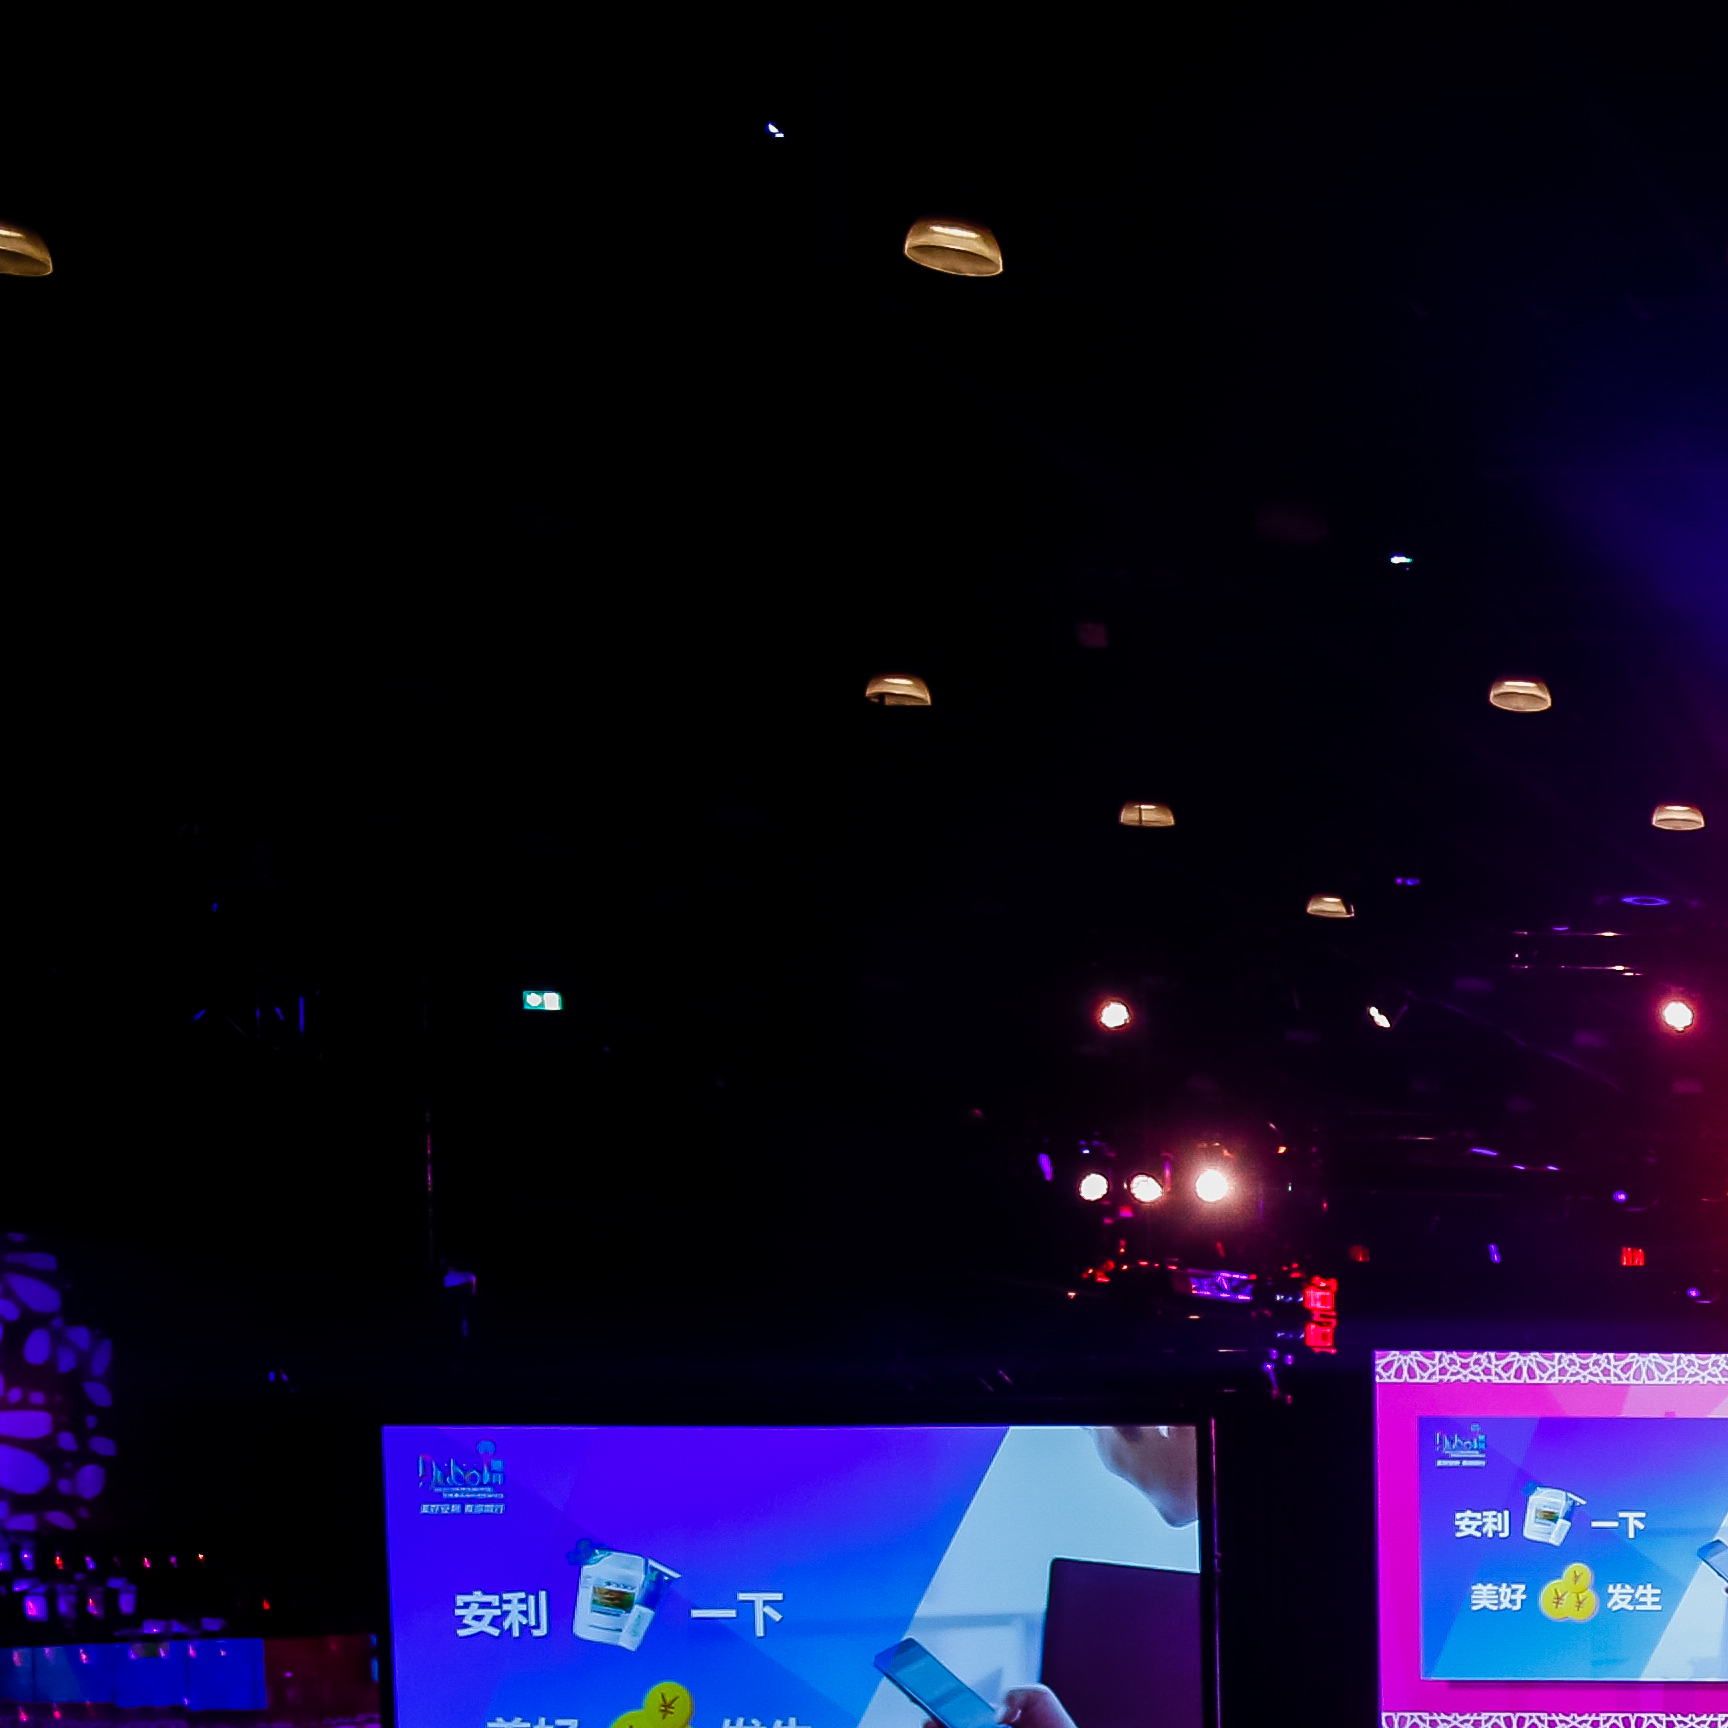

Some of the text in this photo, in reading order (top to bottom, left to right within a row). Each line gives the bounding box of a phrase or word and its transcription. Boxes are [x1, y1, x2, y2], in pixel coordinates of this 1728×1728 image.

[1454, 1509, 1646, 1539] 安利 一下
[1470, 1582, 1663, 1611] 美好 发生
[454, 1590, 784, 1638] 安利 一下
